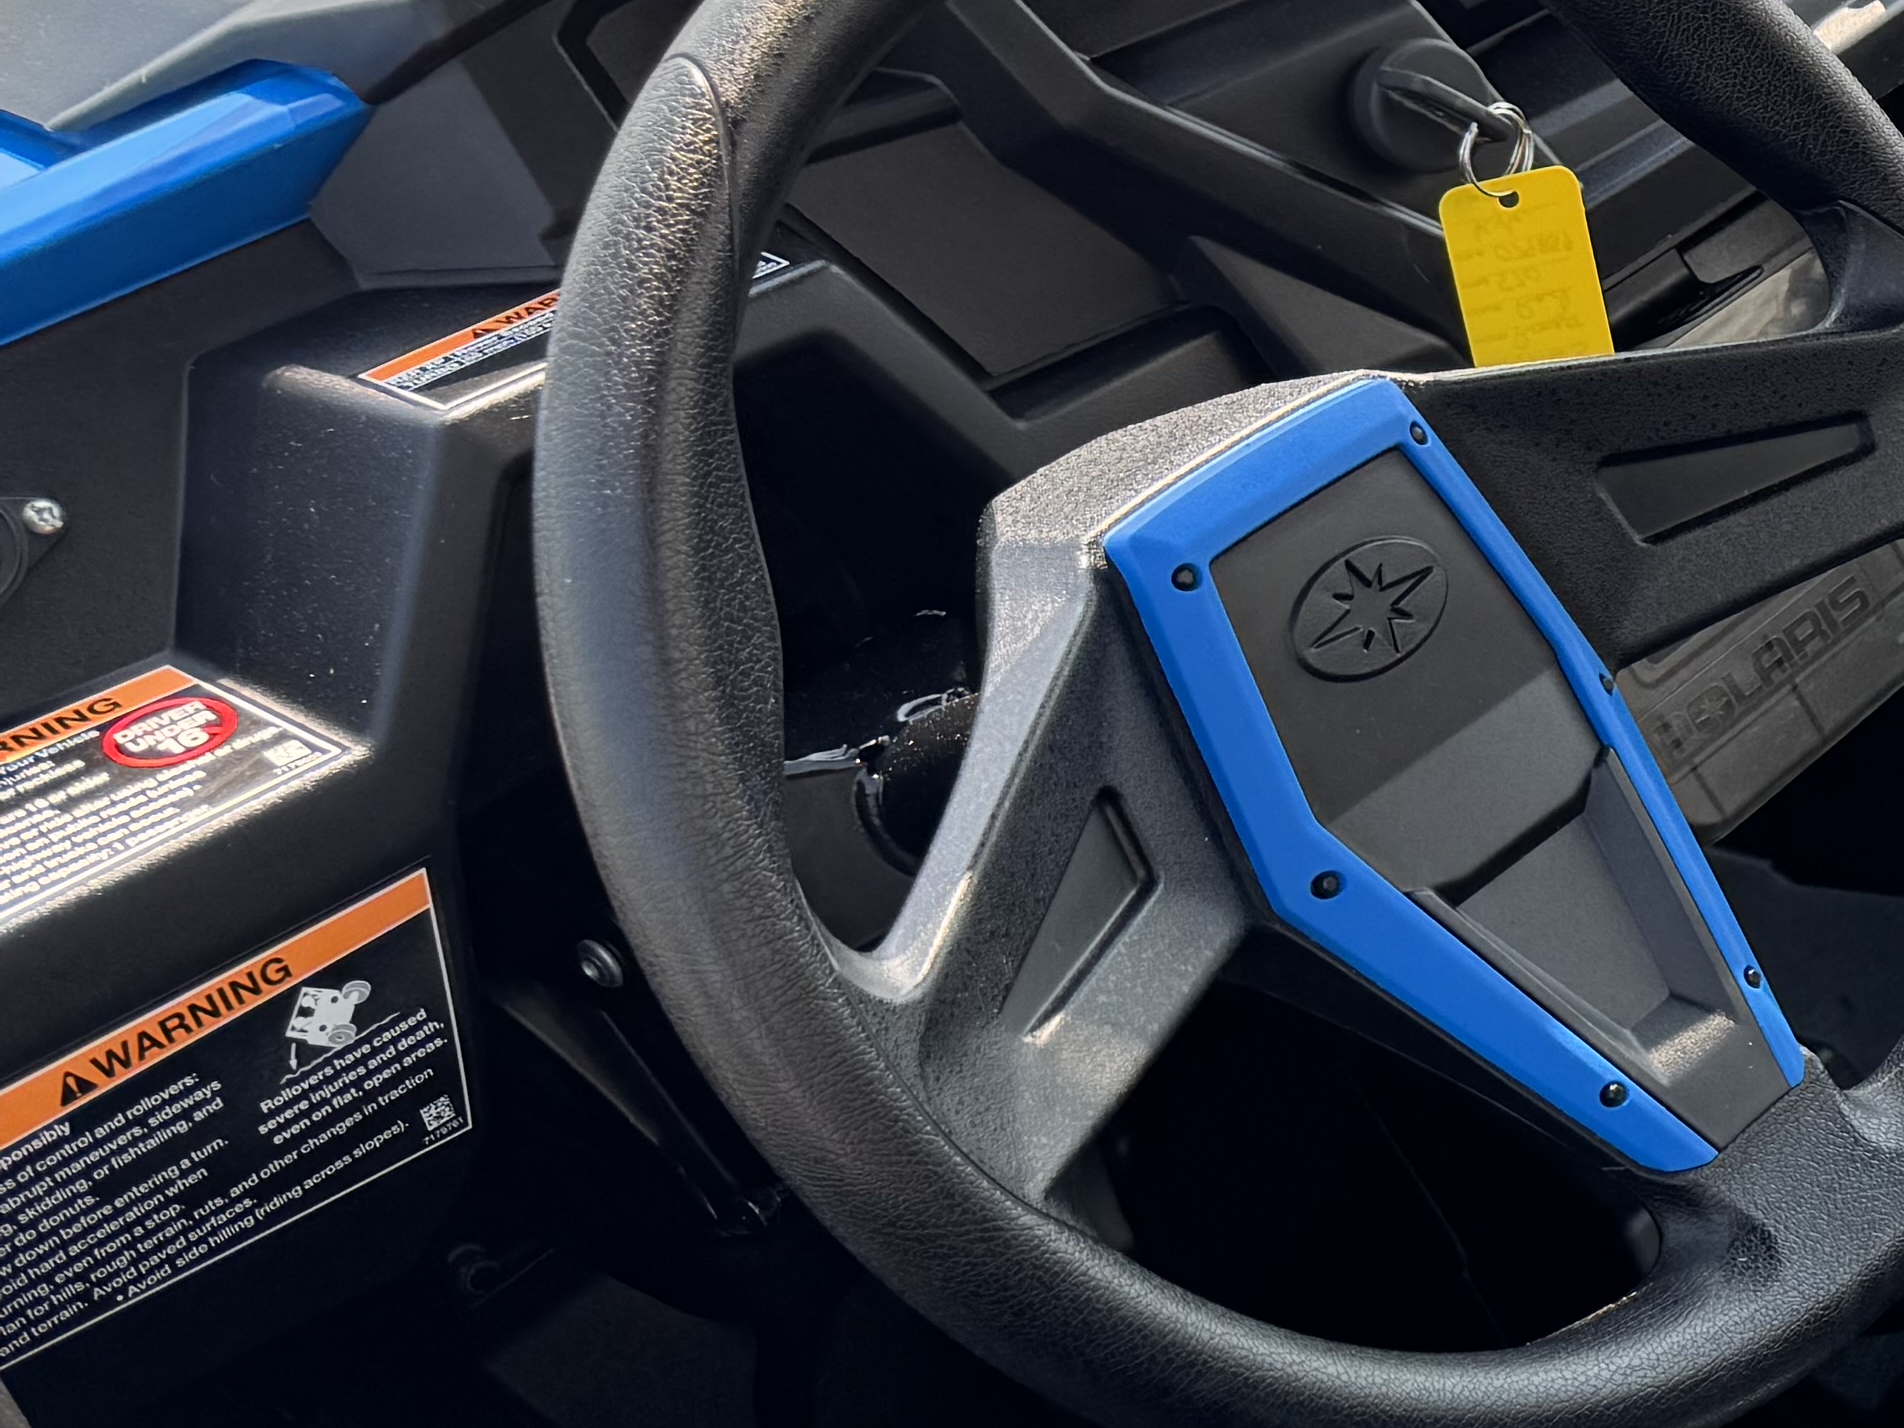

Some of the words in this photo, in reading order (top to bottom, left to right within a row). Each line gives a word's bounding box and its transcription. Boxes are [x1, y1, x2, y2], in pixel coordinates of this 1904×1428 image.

[1651, 574, 1871, 762] POLARIS
[114, 701, 206, 744] DRIVER
[125, 710, 217, 752] UNDER
[157, 727, 209, 754] 16
[89, 956, 295, 1082] WARNING
[260, 1066, 334, 1113] Rollovers
[334, 1044, 371, 1070] have
[373, 1008, 427, 1047] caused
[258, 1100, 309, 1134] severe
[310, 1066, 367, 1103] injuries
[367, 1045, 396, 1069] and
[397, 1021, 444, 1051] death,
[273, 1118, 311, 1145] even
[311, 1105, 332, 1121] on
[333, 1088, 363, 1109] flat,
[363, 1063, 401, 1090] open
[402, 1037, 448, 1067] areas.
[0, 1122, 70, 1170] ponsibly
[0, 1176, 54, 1214] abrupt
[148, 1081, 221, 1127] sideways
[18, 1165, 35, 1183] of
[36, 1131, 93, 1171] control
[94, 1113, 126, 1138] and
[93, 1164, 110, 1180] or
[193, 1097, 224, 1121] and
[0, 1273, 28, 1298] oid
[29, 1250, 67, 1279] hard
[68, 1194, 164, 1256] acceleration
[165, 1168, 208, 1197] when
[14, 1229, 37, 1247] do
[15, 1236, 60, 1267] down
[60, 1205, 113, 1240] before
[114, 1165, 180, 1208] entering
[179, 1158, 192, 1169] a
[26, 1301, 49, 1320] for
[90, 1250, 137, 1282] rough
[230, 1173, 259, 1198] and
[260, 1150, 298, 1179] other
[300, 1112, 363, 1154] changes
[363, 1102, 378, 1116] in
[378, 1068, 434, 1106] traction
[128, 1264, 172, 1297] Avoid
[175, 1244, 208, 1268] side
[208, 1215, 255, 1247] hilling
[255, 1186, 303, 1220] (riding
[303, 1155, 352, 1189] across
[0, 1332, 30, 1357] and
[93, 1266, 138, 1300] Avoid
[138, 1235, 187, 1274] paved
[54, 1256, 94, 1284] even
[94, 1233, 132, 1260] from
[133, 1226, 145, 1237] a
